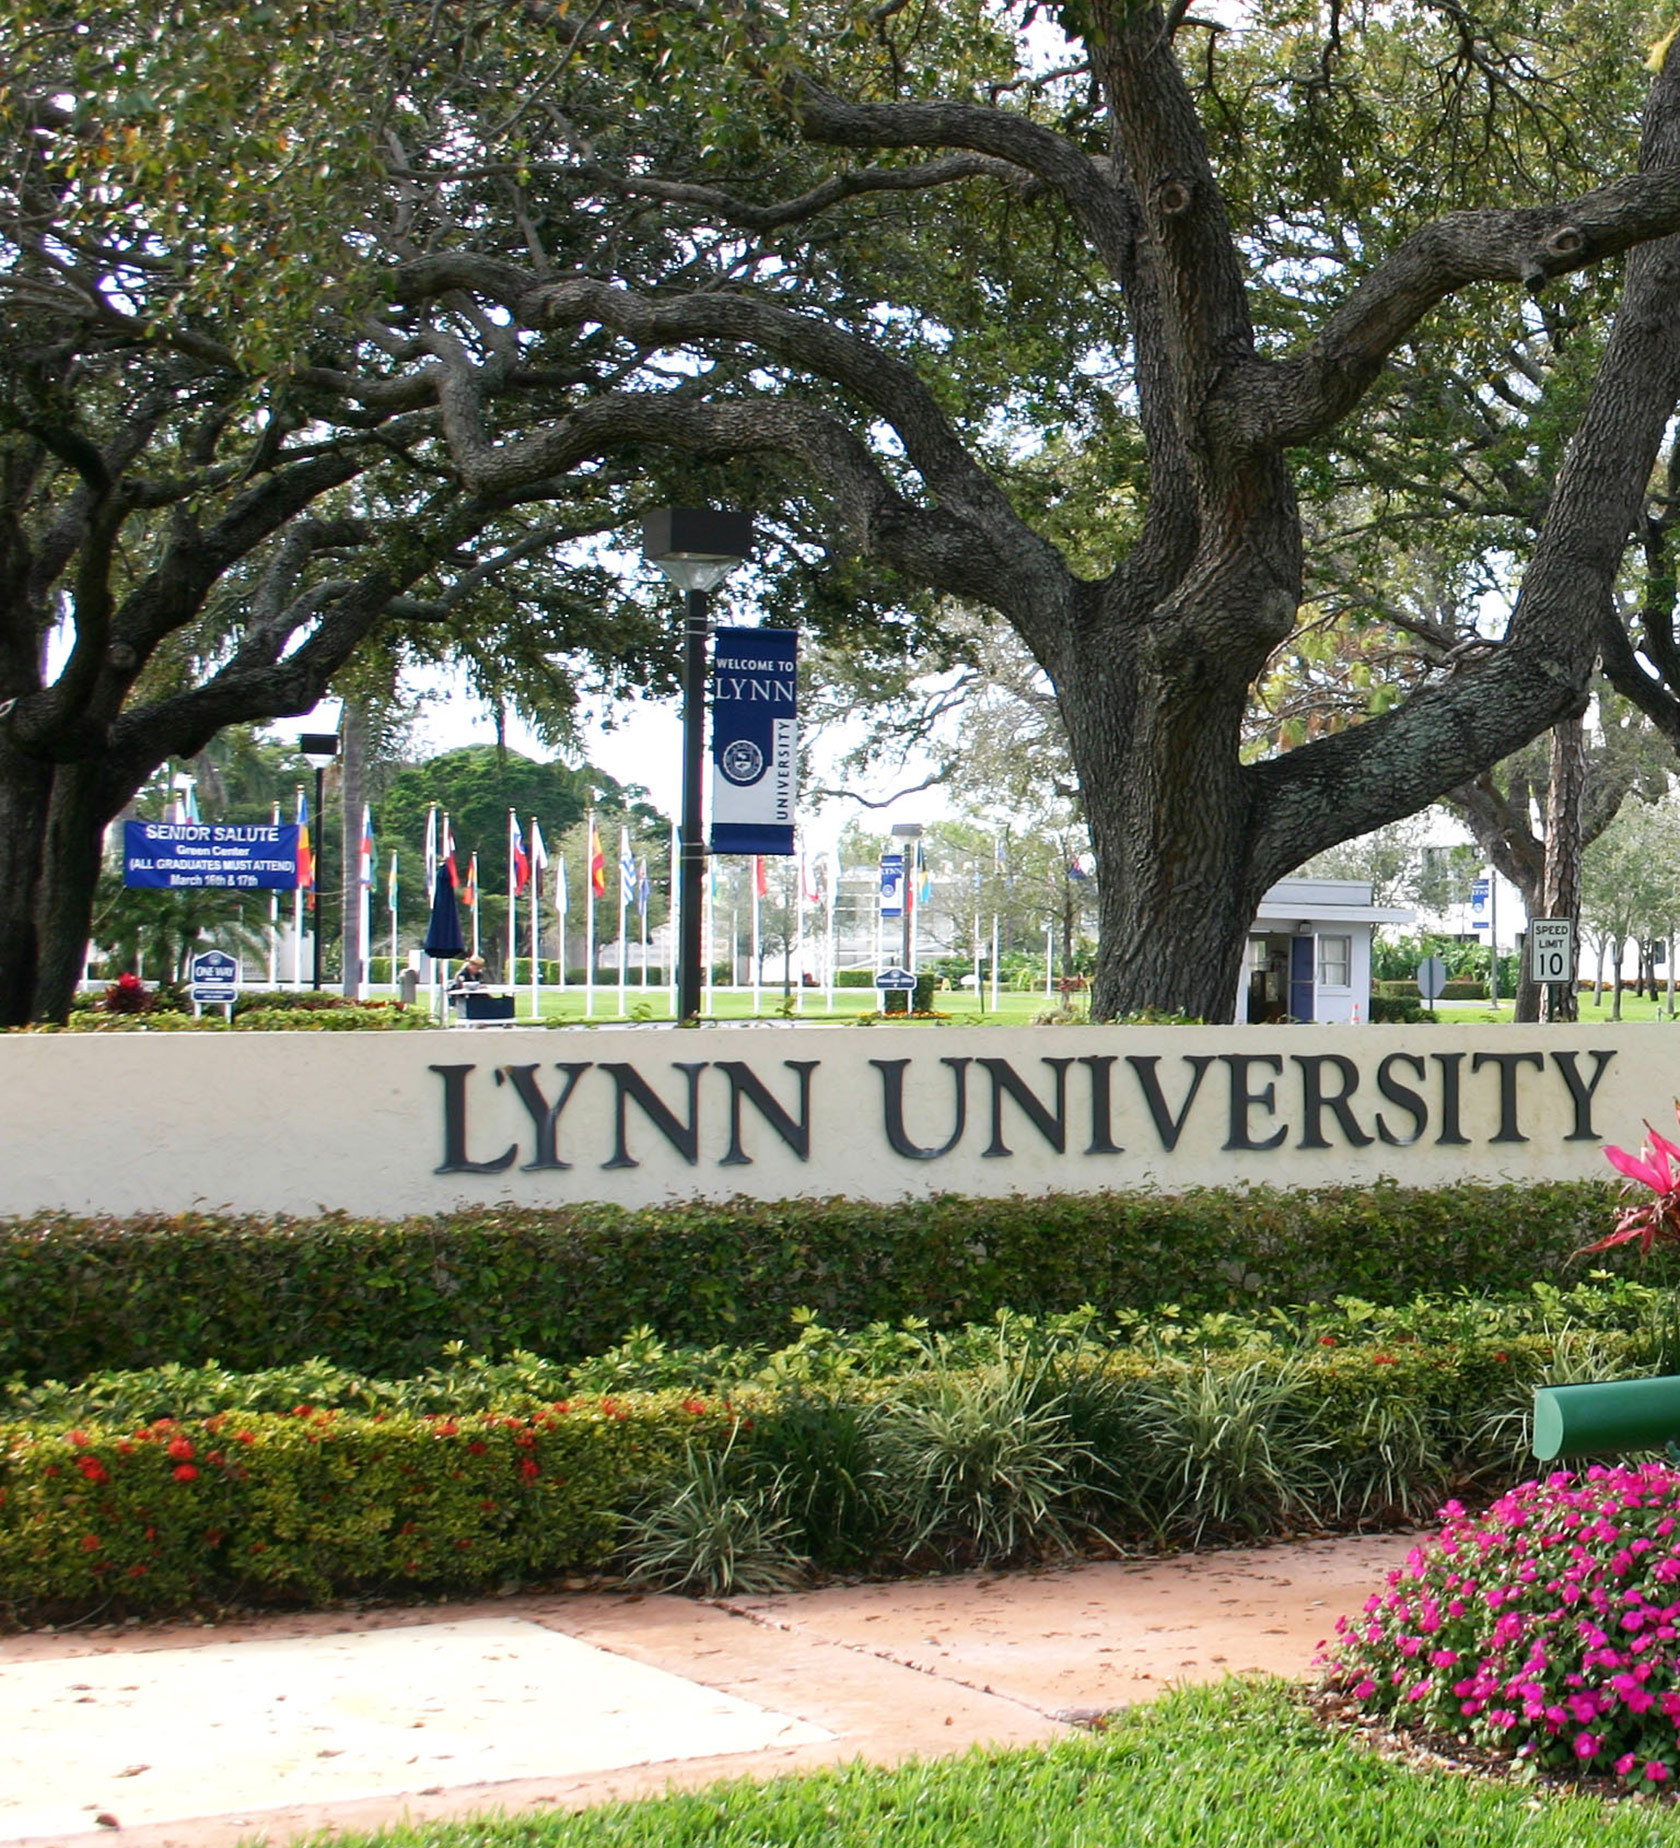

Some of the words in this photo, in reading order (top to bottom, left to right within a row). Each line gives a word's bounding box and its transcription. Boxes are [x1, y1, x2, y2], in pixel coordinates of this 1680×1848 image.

[716, 658, 774, 671] WELCOME
[778, 661, 794, 672] TO
[715, 677, 795, 702] LYNN
[776, 722, 790, 820] UNIVERSITY
[145, 825, 210, 841] SENIOR
[214, 827, 280, 842] SALUTE
[176, 845, 210, 856] Green
[212, 846, 250, 856] Center
[130, 858, 154, 871] (ALL
[156, 859, 222, 871] GRADUATES
[223, 860, 252, 871] MUST
[252, 860, 296, 873] ATTEND)
[170, 874, 203, 886] March
[227, 875, 236, 886] &
[237, 875, 258, 886] 17th
[1535, 925, 1569, 935] SPEED
[1539, 939, 1564, 948] LIMIT
[195, 966, 215, 977] ONE
[215, 966, 235, 977] WAY
[1540, 953, 1563, 976] 10
[868, 1049, 1618, 1161] UNIVERSITY
